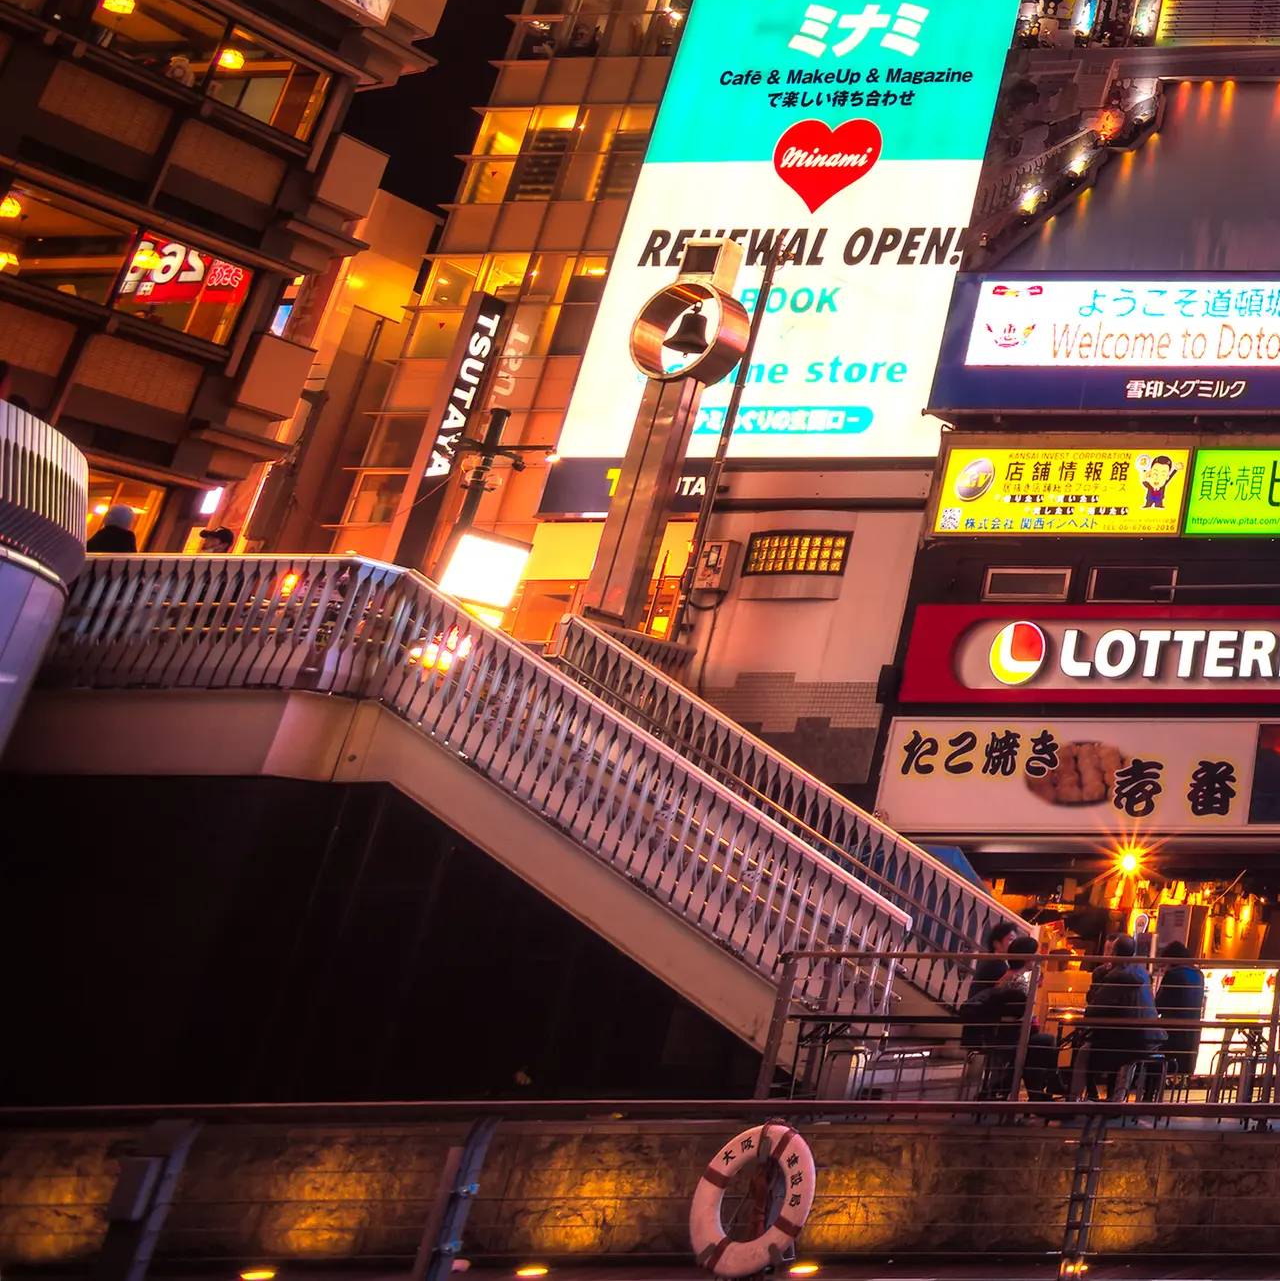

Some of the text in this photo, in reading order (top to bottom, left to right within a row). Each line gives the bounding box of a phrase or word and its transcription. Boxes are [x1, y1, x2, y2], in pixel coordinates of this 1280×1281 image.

[787, 3, 930, 58] ミナミ
[767, 69, 780, 84] &
[786, 68, 861, 86] MakeUp
[866, 68, 880, 84] &
[885, 67, 973, 86] Magazine
[768, 89, 916, 108] で楽しい待ち合わせ
[779, 145, 872, 169] Minami
[1051, 322, 1171, 360] Welcome
[1181, 328, 1206, 359] to
[805, 354, 907, 383] store
[424, 313, 500, 477] TSUTAYA
[1126, 379, 1246, 399] 雪印メグミルク
[1072, 452, 1132, 460] CORPORATION
[1005, 461, 1130, 482] 店舗情報館
[964, 518, 1014, 530] 株式会社
[1191, 517, 1280, 526] http://www.pitat.com/
[901, 729, 1062, 779] たこ焼き
